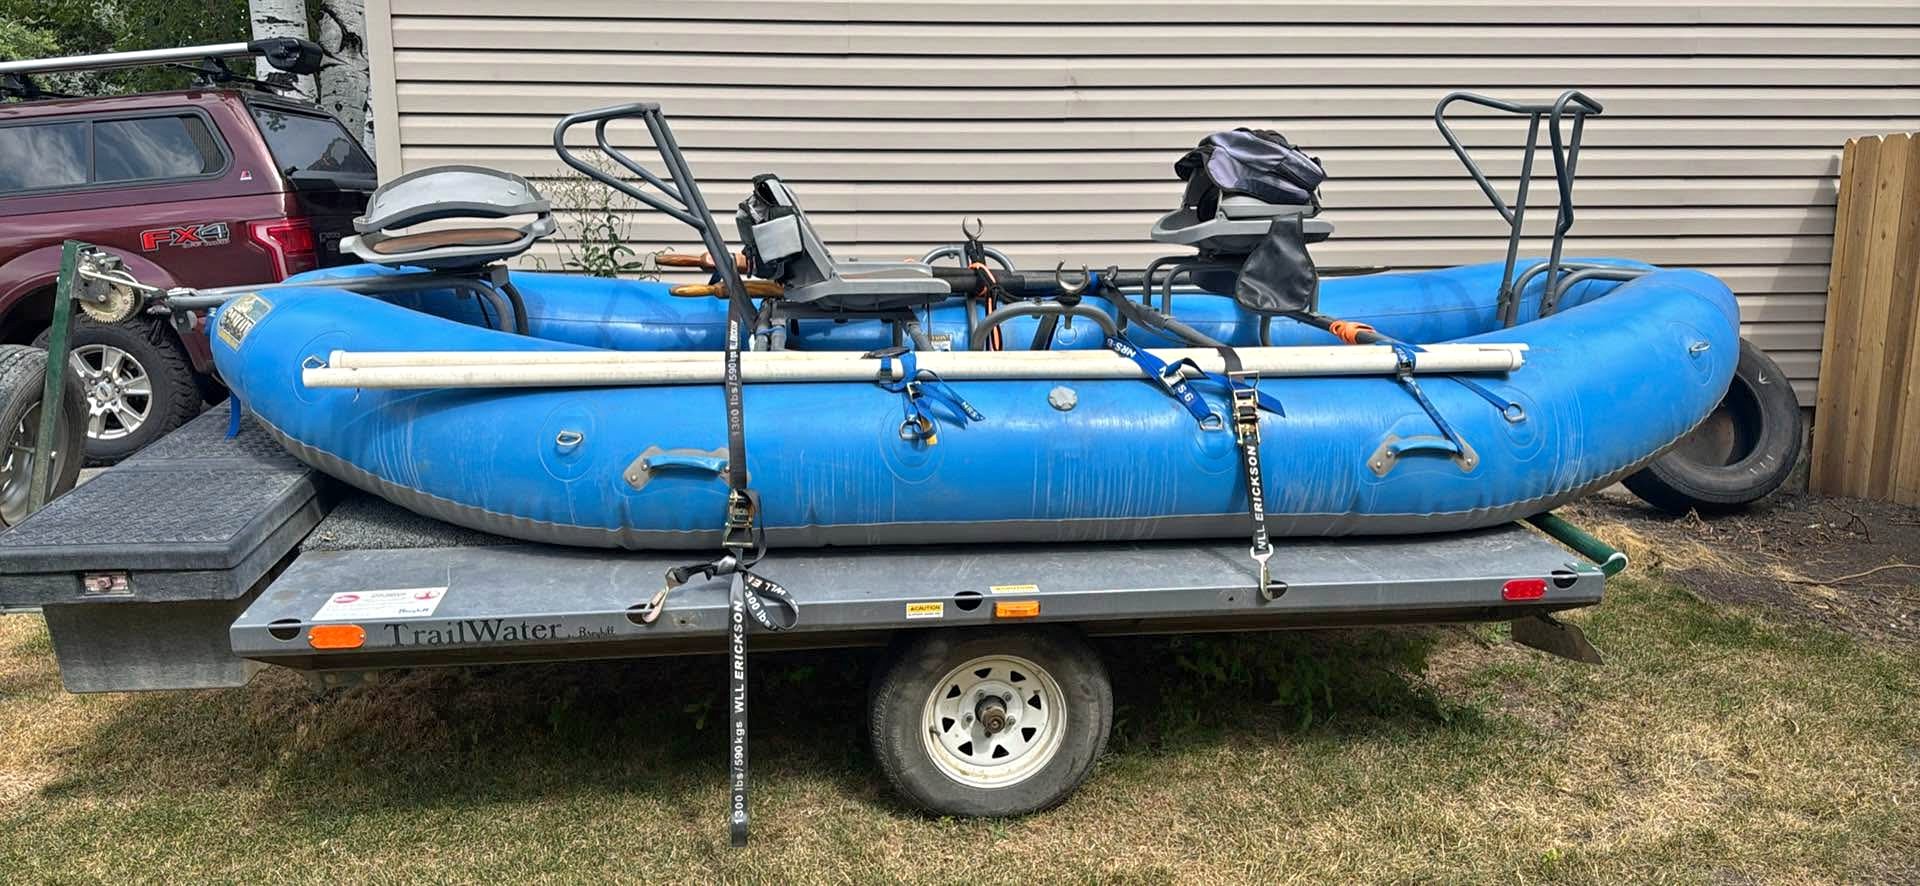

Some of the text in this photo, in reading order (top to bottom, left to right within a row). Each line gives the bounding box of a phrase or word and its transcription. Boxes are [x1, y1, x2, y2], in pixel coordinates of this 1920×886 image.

[140, 222, 230, 252] FX4
[1246, 445, 1264, 521] ERICKSON
[384, 618, 562, 648] TrailWater
[733, 600, 744, 681] ERICKSON
[734, 683, 745, 714] WLL
[734, 794, 744, 824] 1300
